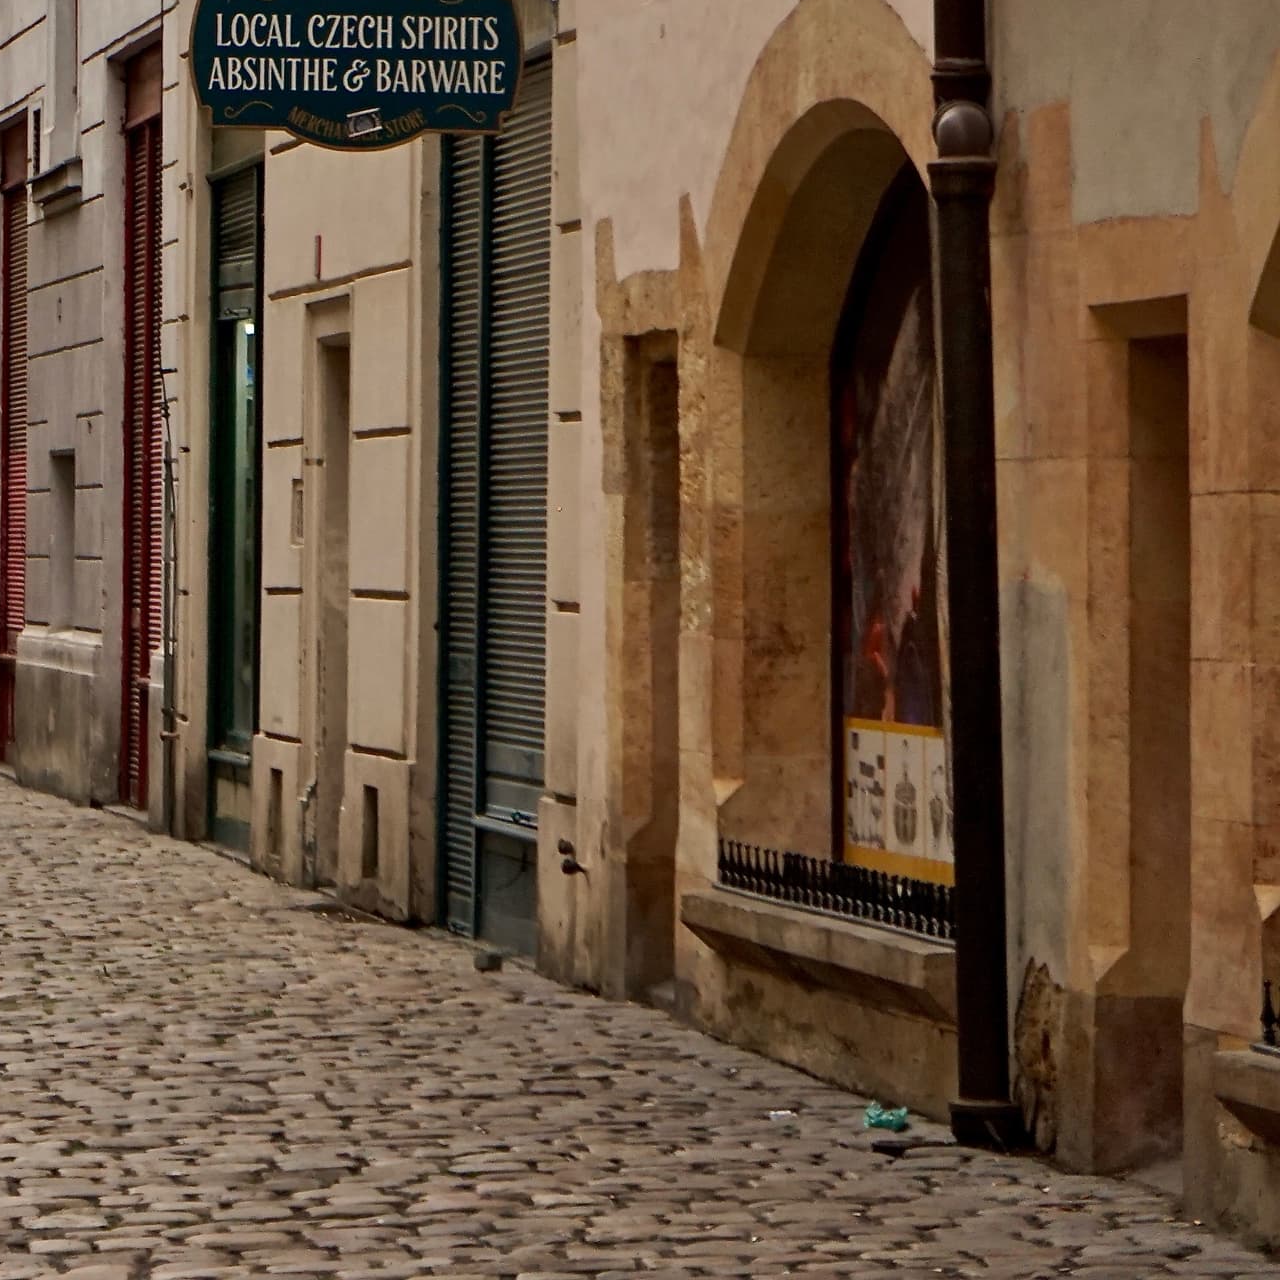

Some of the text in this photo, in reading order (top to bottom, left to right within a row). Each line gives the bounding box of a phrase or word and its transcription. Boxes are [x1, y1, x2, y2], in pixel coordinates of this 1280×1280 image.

[216, 13, 499, 51] LOCAL CZECH SPIRITS
[208, 56, 506, 95] ABSINTHE & BARWARE
[386, 109, 427, 138] STORE
